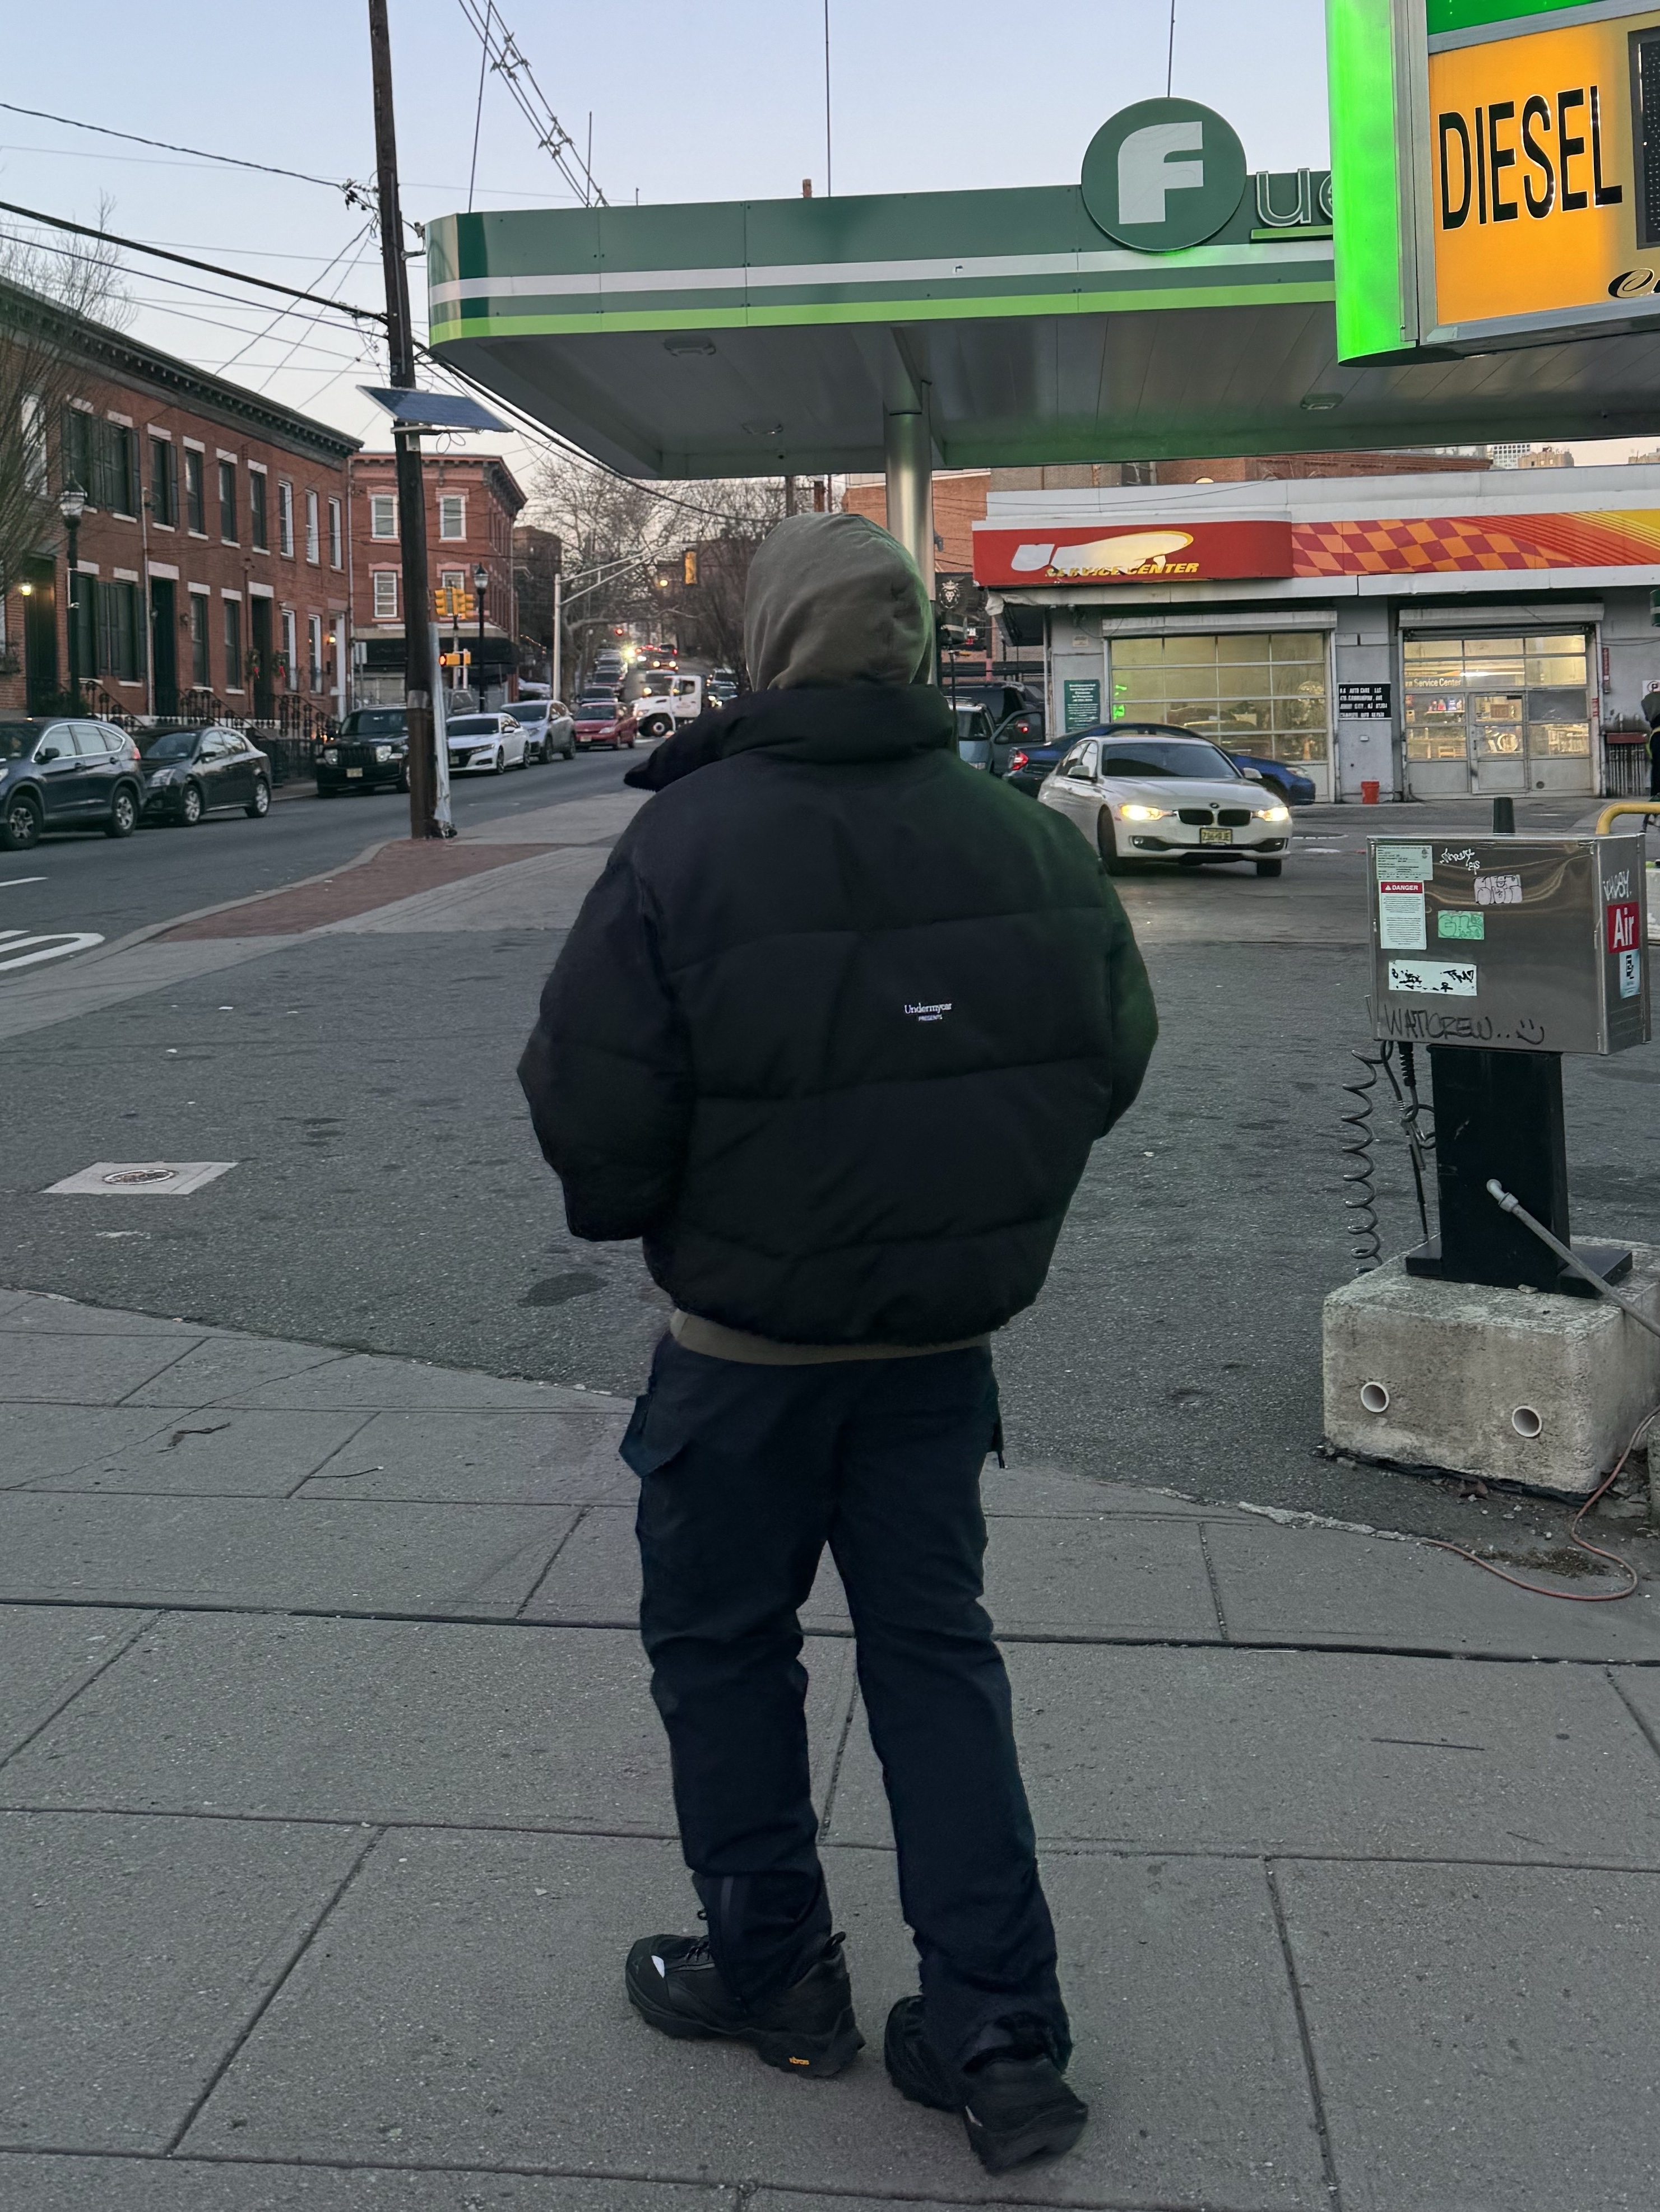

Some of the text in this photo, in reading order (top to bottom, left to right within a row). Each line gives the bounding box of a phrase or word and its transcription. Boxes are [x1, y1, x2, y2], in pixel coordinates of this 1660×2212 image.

[1438, 86, 1623, 230] DIESEL
[1126, 563, 1200, 575] CENTER
[1613, 907, 1634, 949] Air
